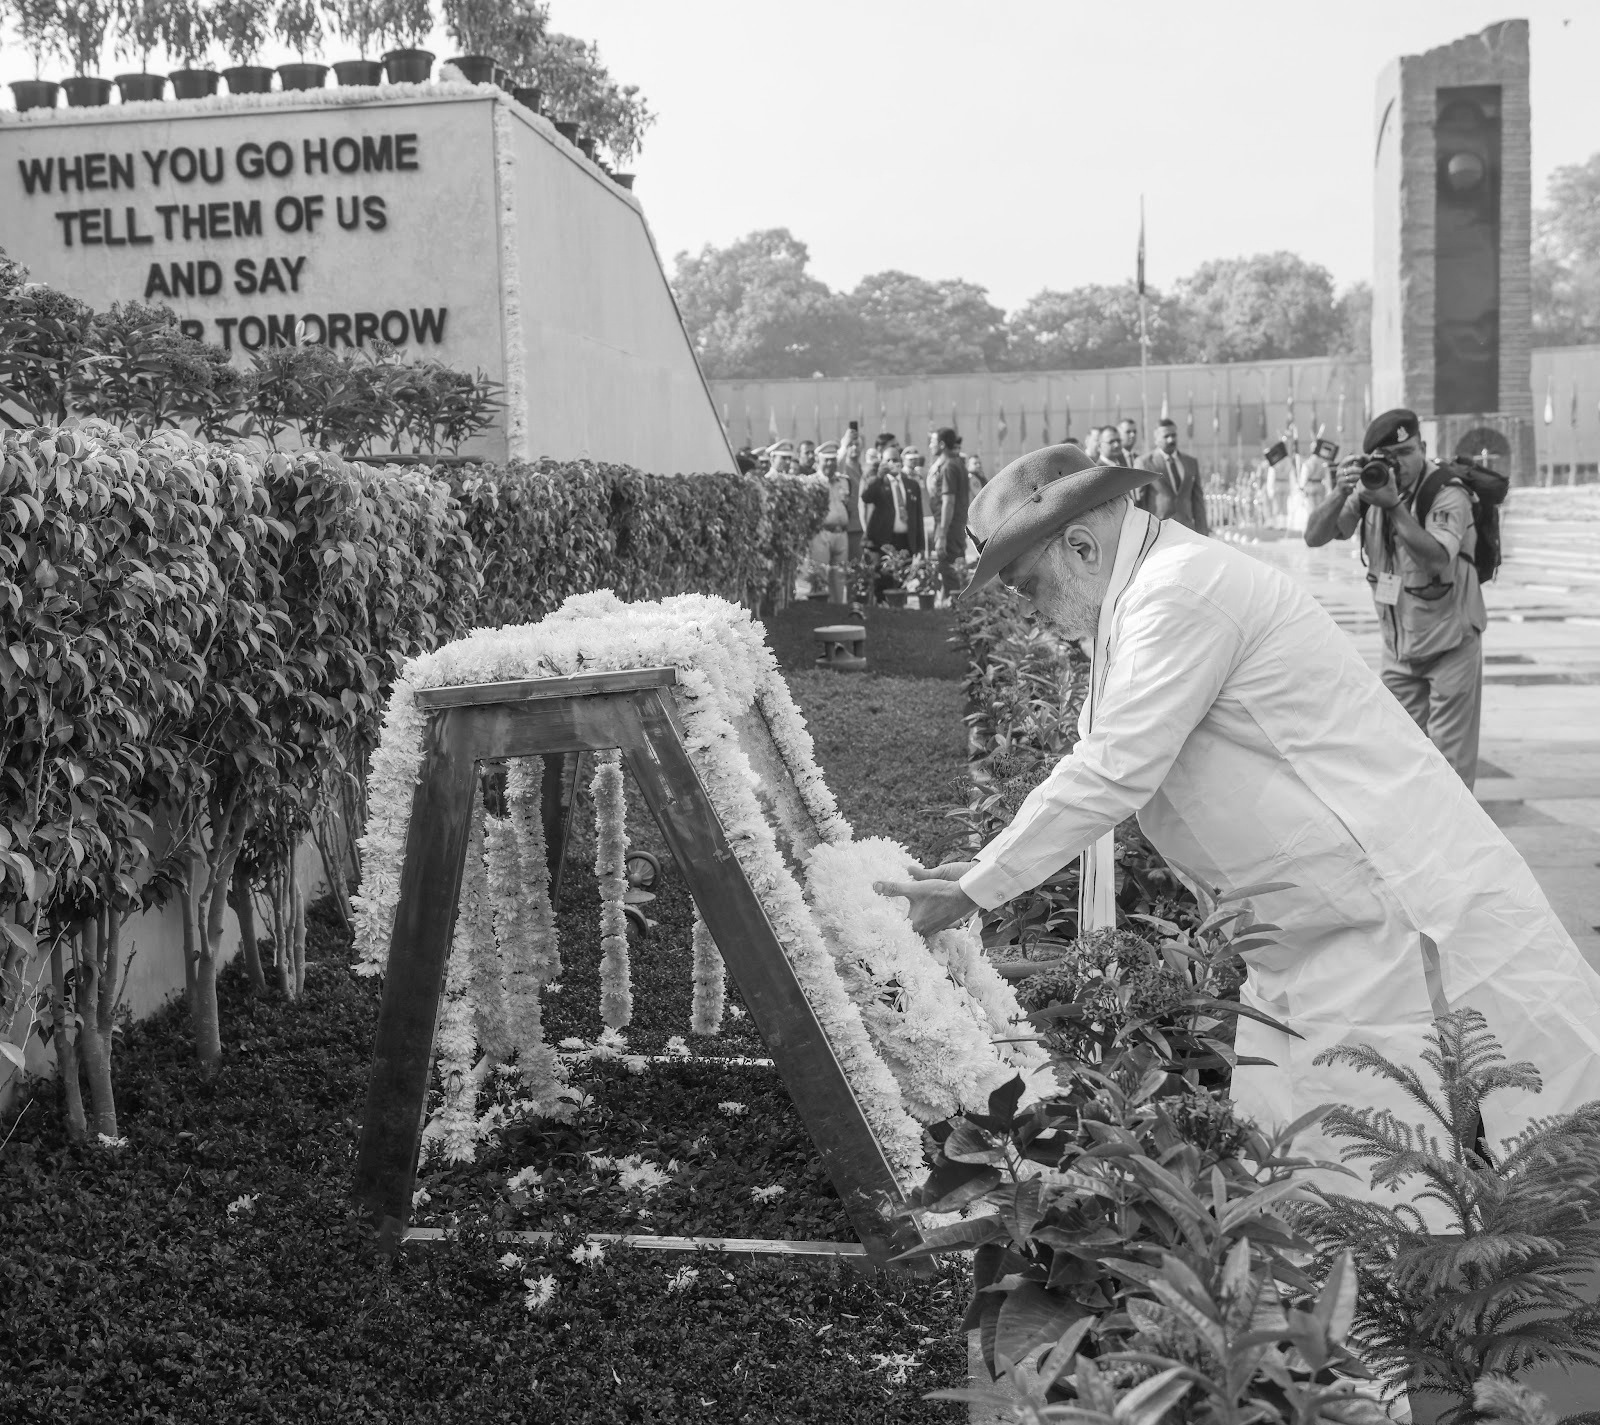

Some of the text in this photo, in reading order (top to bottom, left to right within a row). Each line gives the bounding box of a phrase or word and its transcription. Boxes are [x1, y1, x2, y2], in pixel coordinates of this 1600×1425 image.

[18, 133, 419, 194] WHEN YOU GO HOME
[55, 195, 387, 246] TELL THEM OF US
[144, 256, 306, 298] AND SAY
[215, 307, 447, 352] TOMORROW
